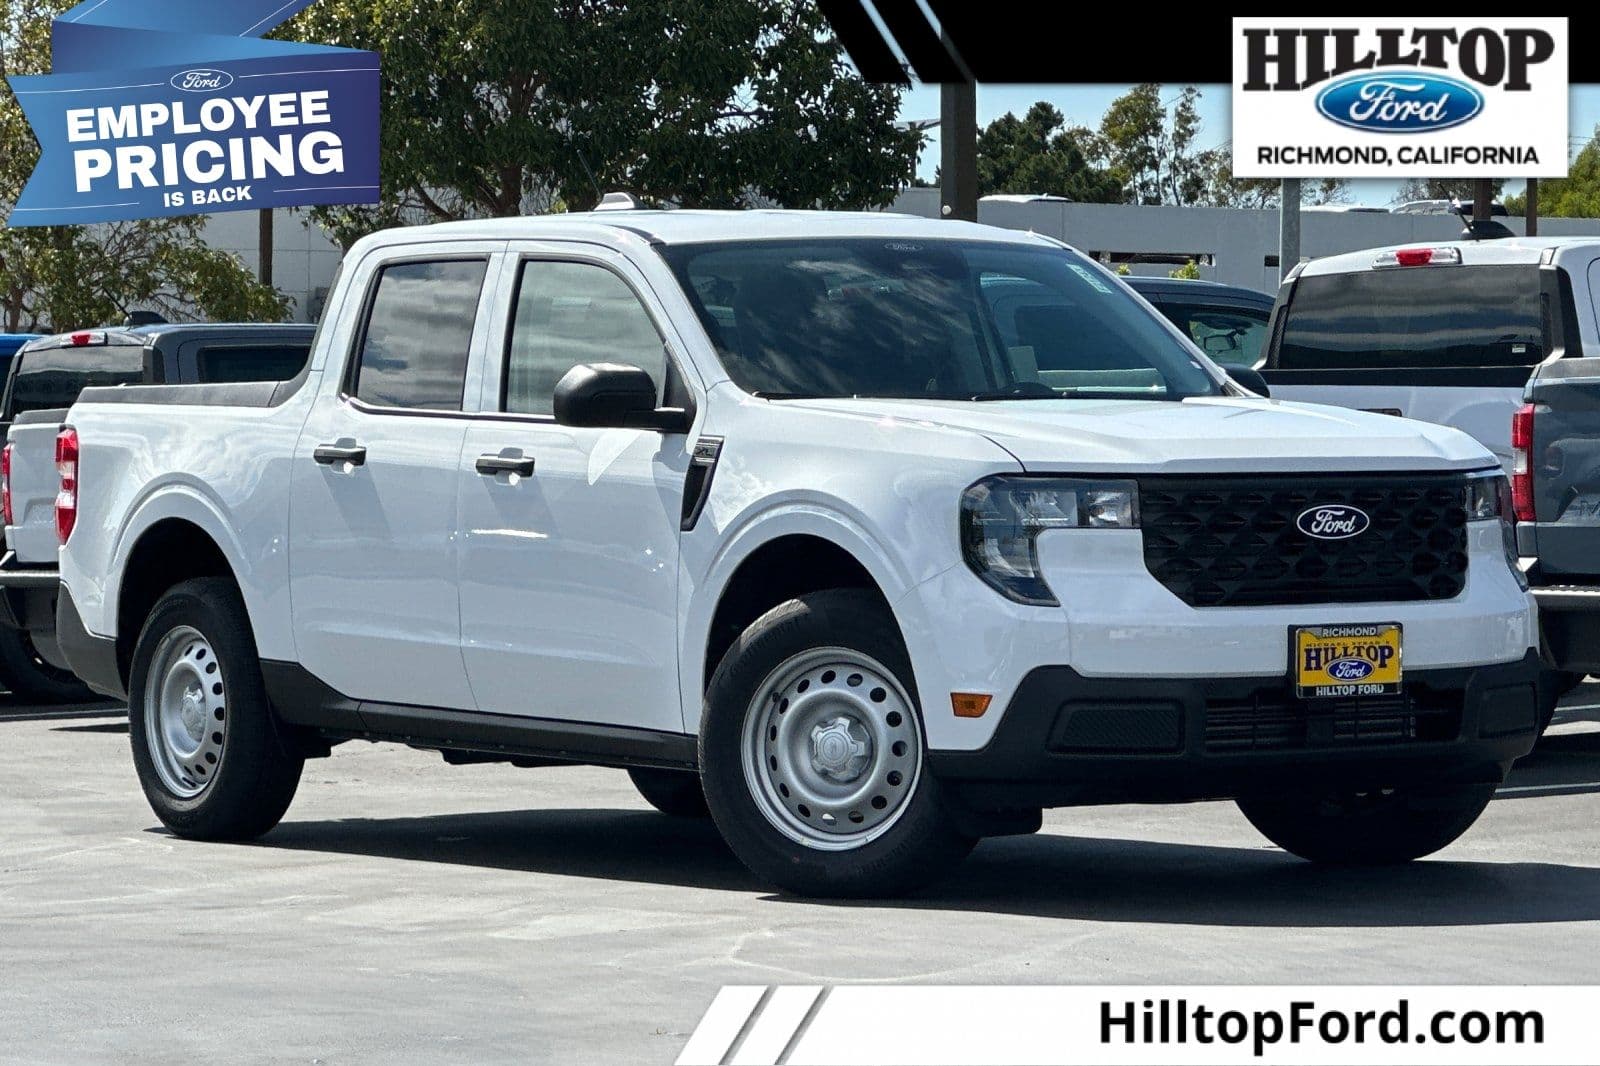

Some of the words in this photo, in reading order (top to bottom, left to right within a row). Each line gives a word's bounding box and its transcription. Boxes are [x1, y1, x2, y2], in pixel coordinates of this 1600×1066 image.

[1311, 509, 1356, 533] Ford
[1322, 627, 1377, 637] RICHMOND
[1304, 645, 1394, 671] HILLTOP
[1335, 661, 1366, 677] Ford
[1316, 685, 1356, 696] HILLTOP
[1358, 684, 1384, 695] FORD
